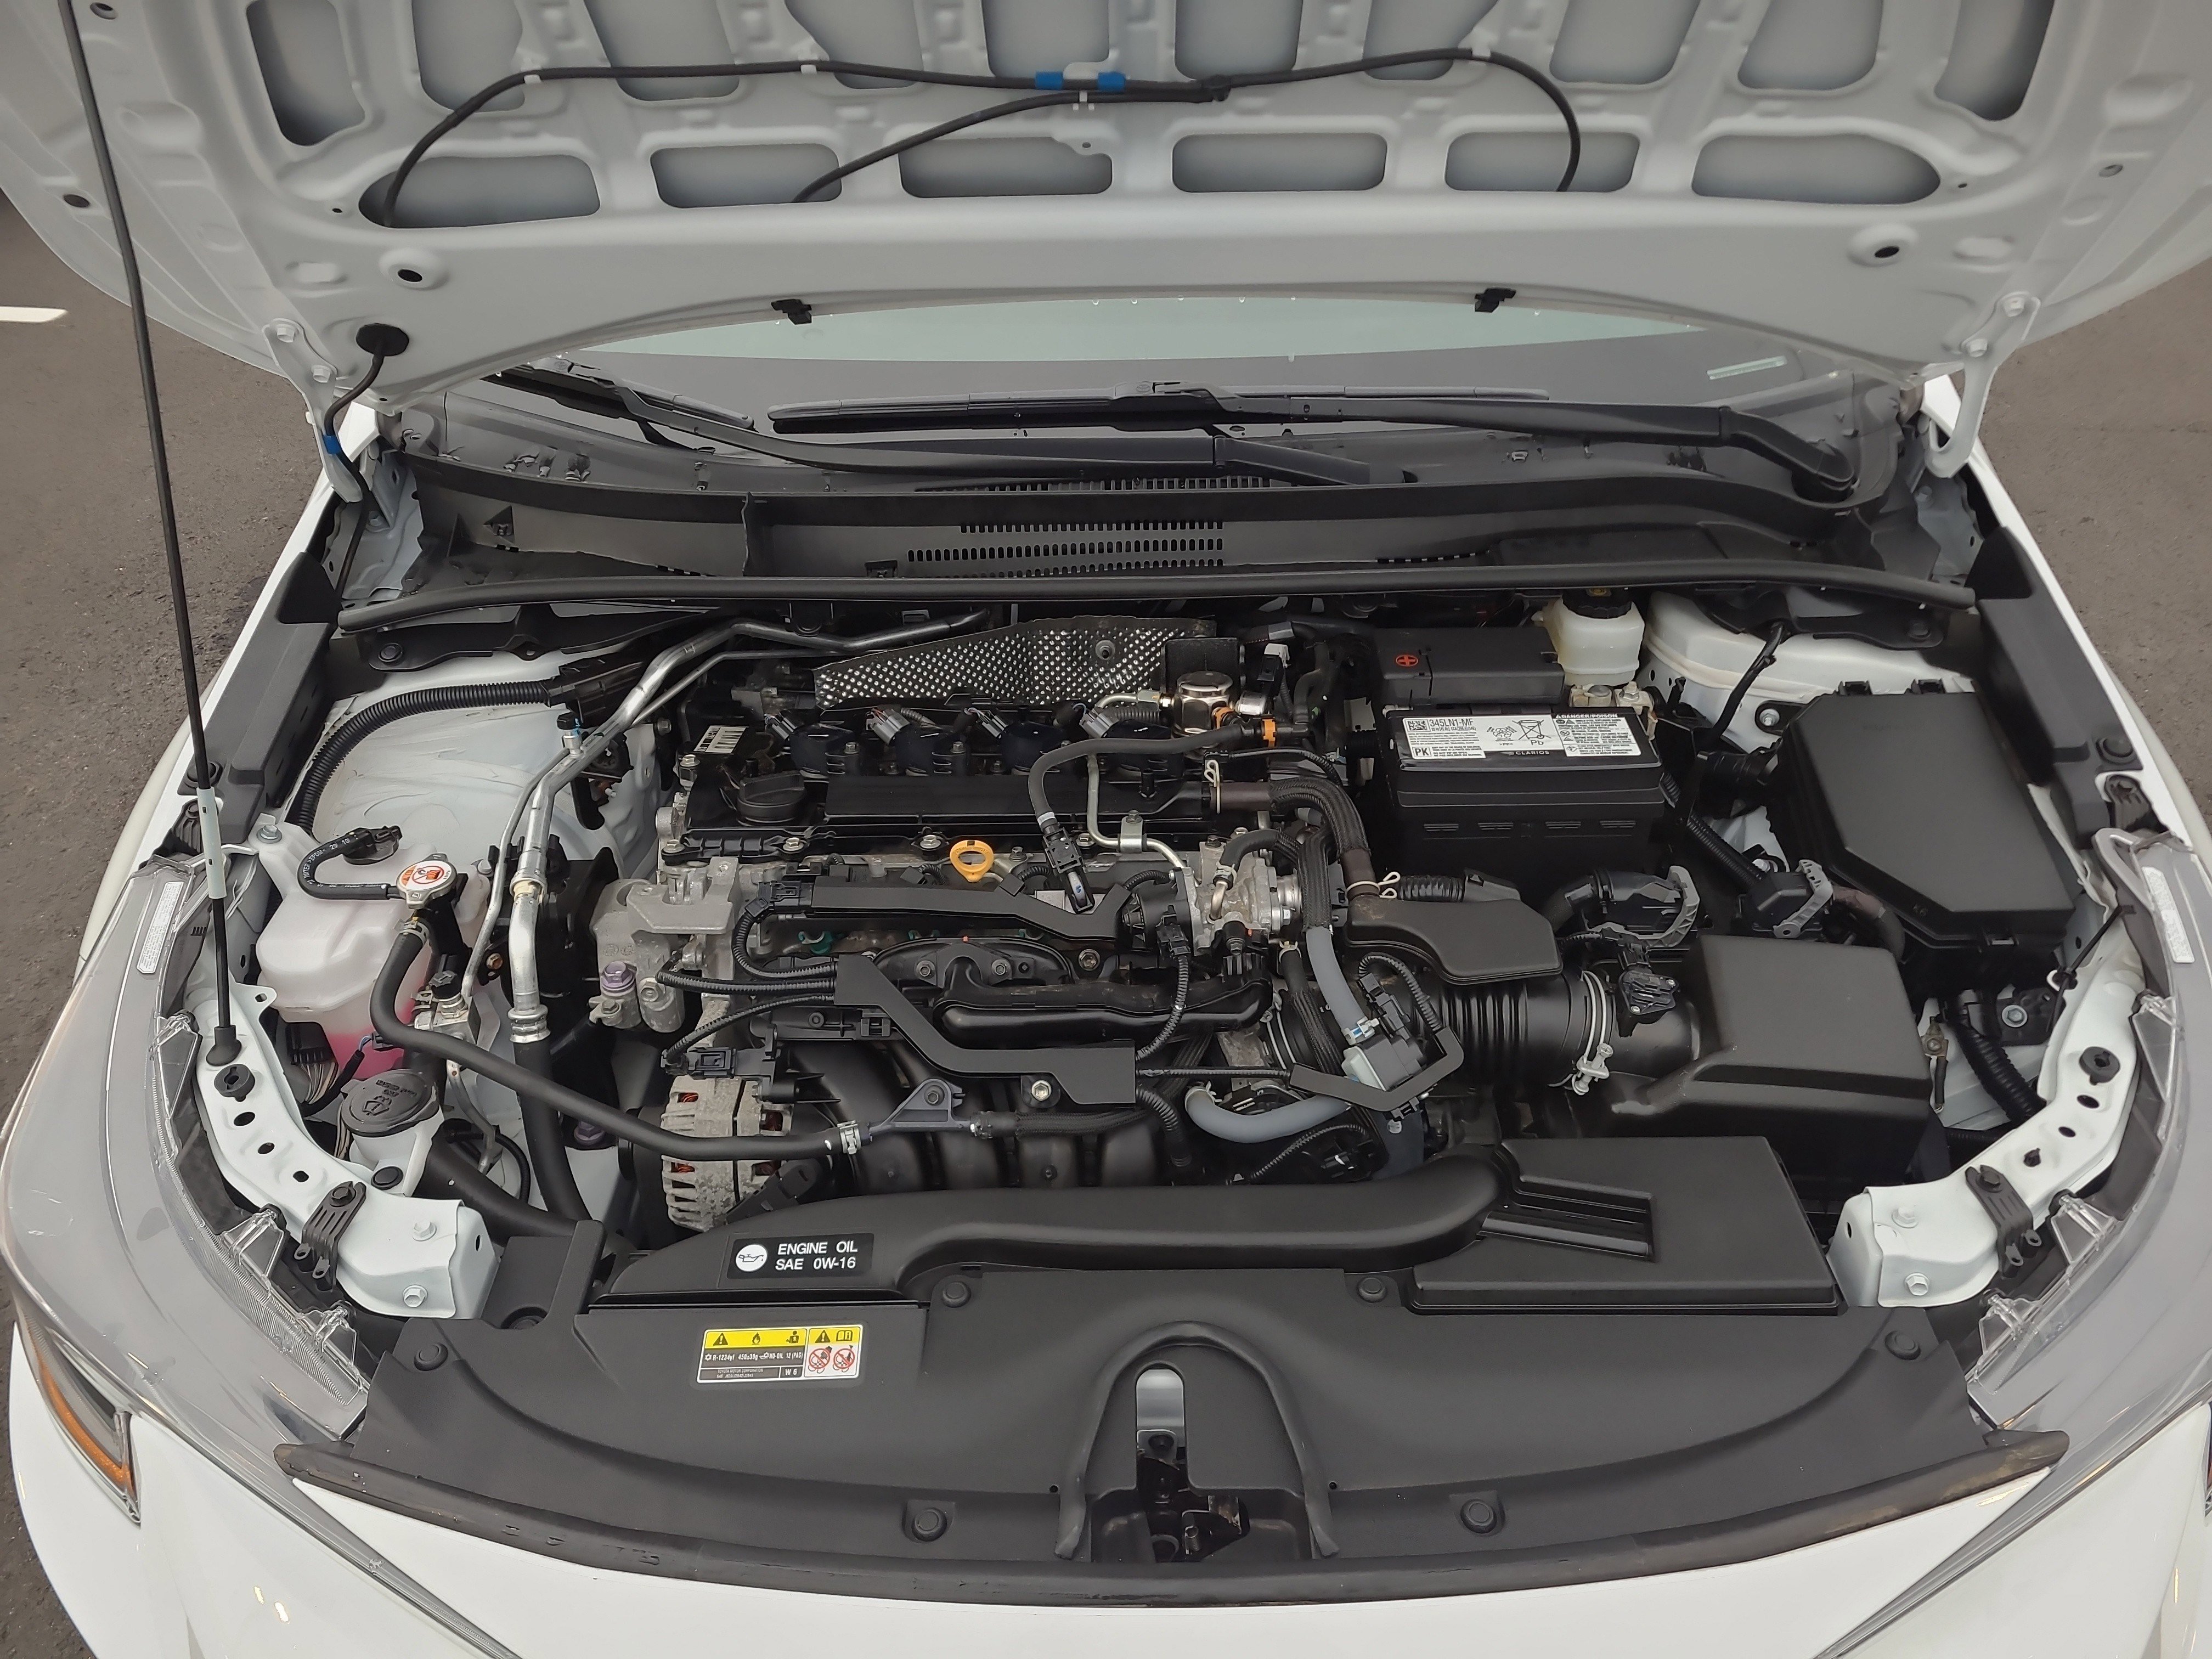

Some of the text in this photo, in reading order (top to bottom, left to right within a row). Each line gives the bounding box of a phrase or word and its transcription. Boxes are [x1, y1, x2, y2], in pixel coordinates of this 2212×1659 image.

[1429, 718, 1474, 727] 345LN1-MF
[1415, 748, 1429, 756] PK
[303, 863, 311, 878] WATER
[777, 1240, 858, 1255] ENGINE OIL
[775, 1256, 856, 1271] SAE 0W-16
